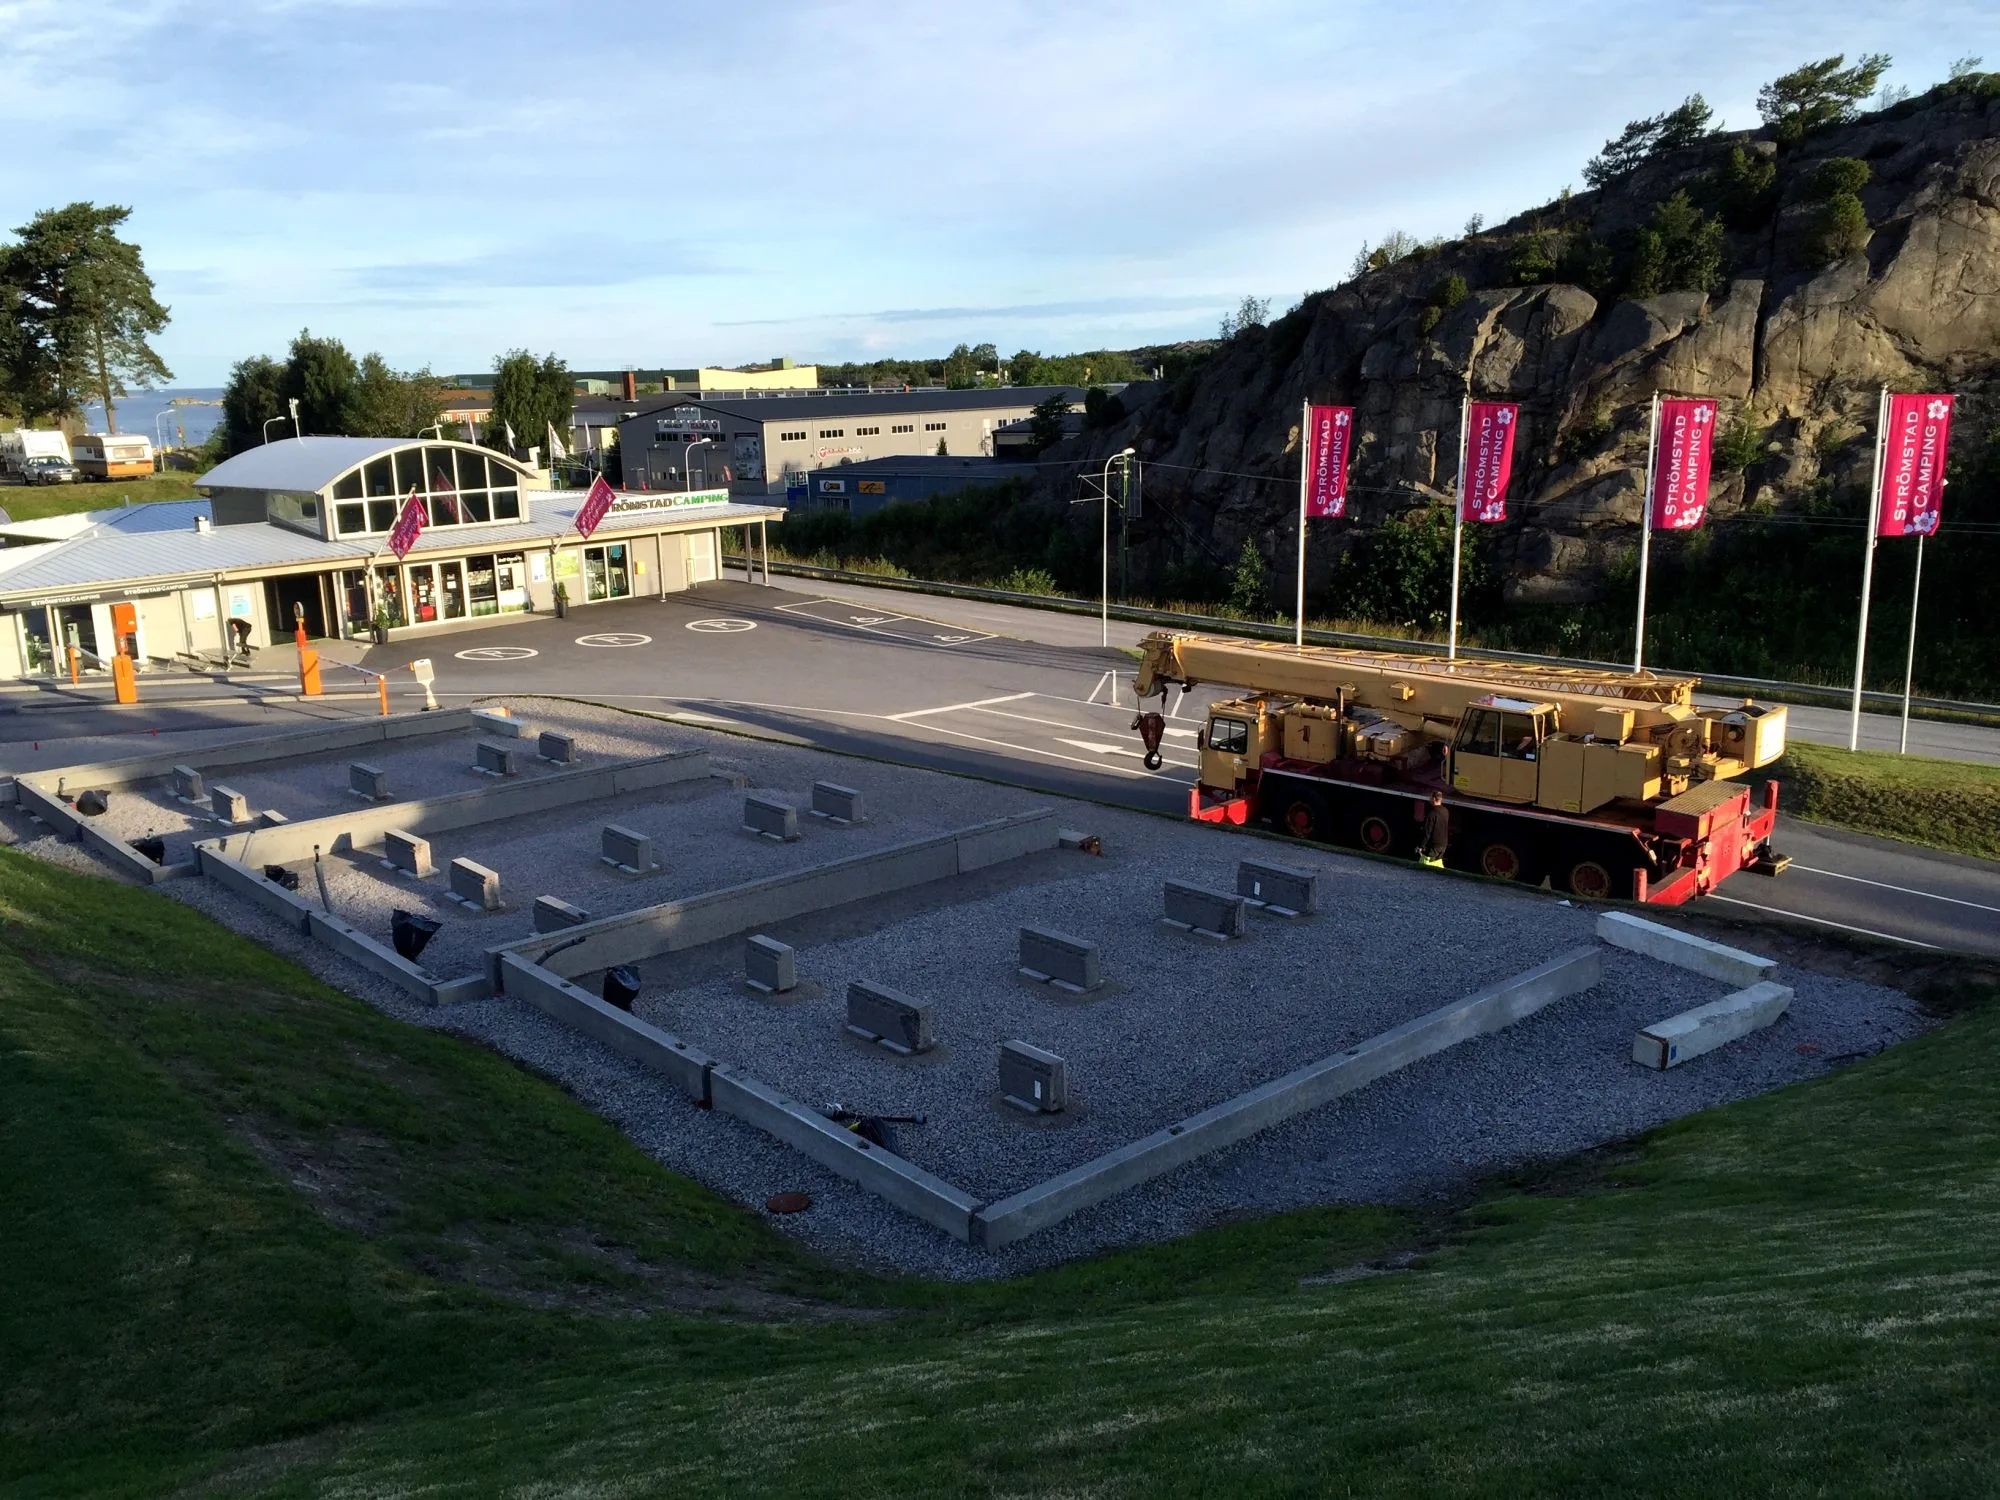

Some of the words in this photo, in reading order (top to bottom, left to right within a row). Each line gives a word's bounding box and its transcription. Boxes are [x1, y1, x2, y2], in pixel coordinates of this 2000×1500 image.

[608, 498, 672, 513] RÖMSTAD
[672, 494, 728, 506] CAMPING
[1316, 419, 1330, 505] STRÖMSTAD
[1330, 431, 1343, 495] CAMPING
[1472, 417, 1491, 510] STRÖMSTAD
[1486, 430, 1504, 499] CAMPING
[1664, 415, 1686, 516] STRÖMSTAD
[1683, 428, 1702, 504] CAMPING
[1893, 411, 1919, 521] STRÖMSTAD
[1913, 425, 1937, 508] CAMPING
